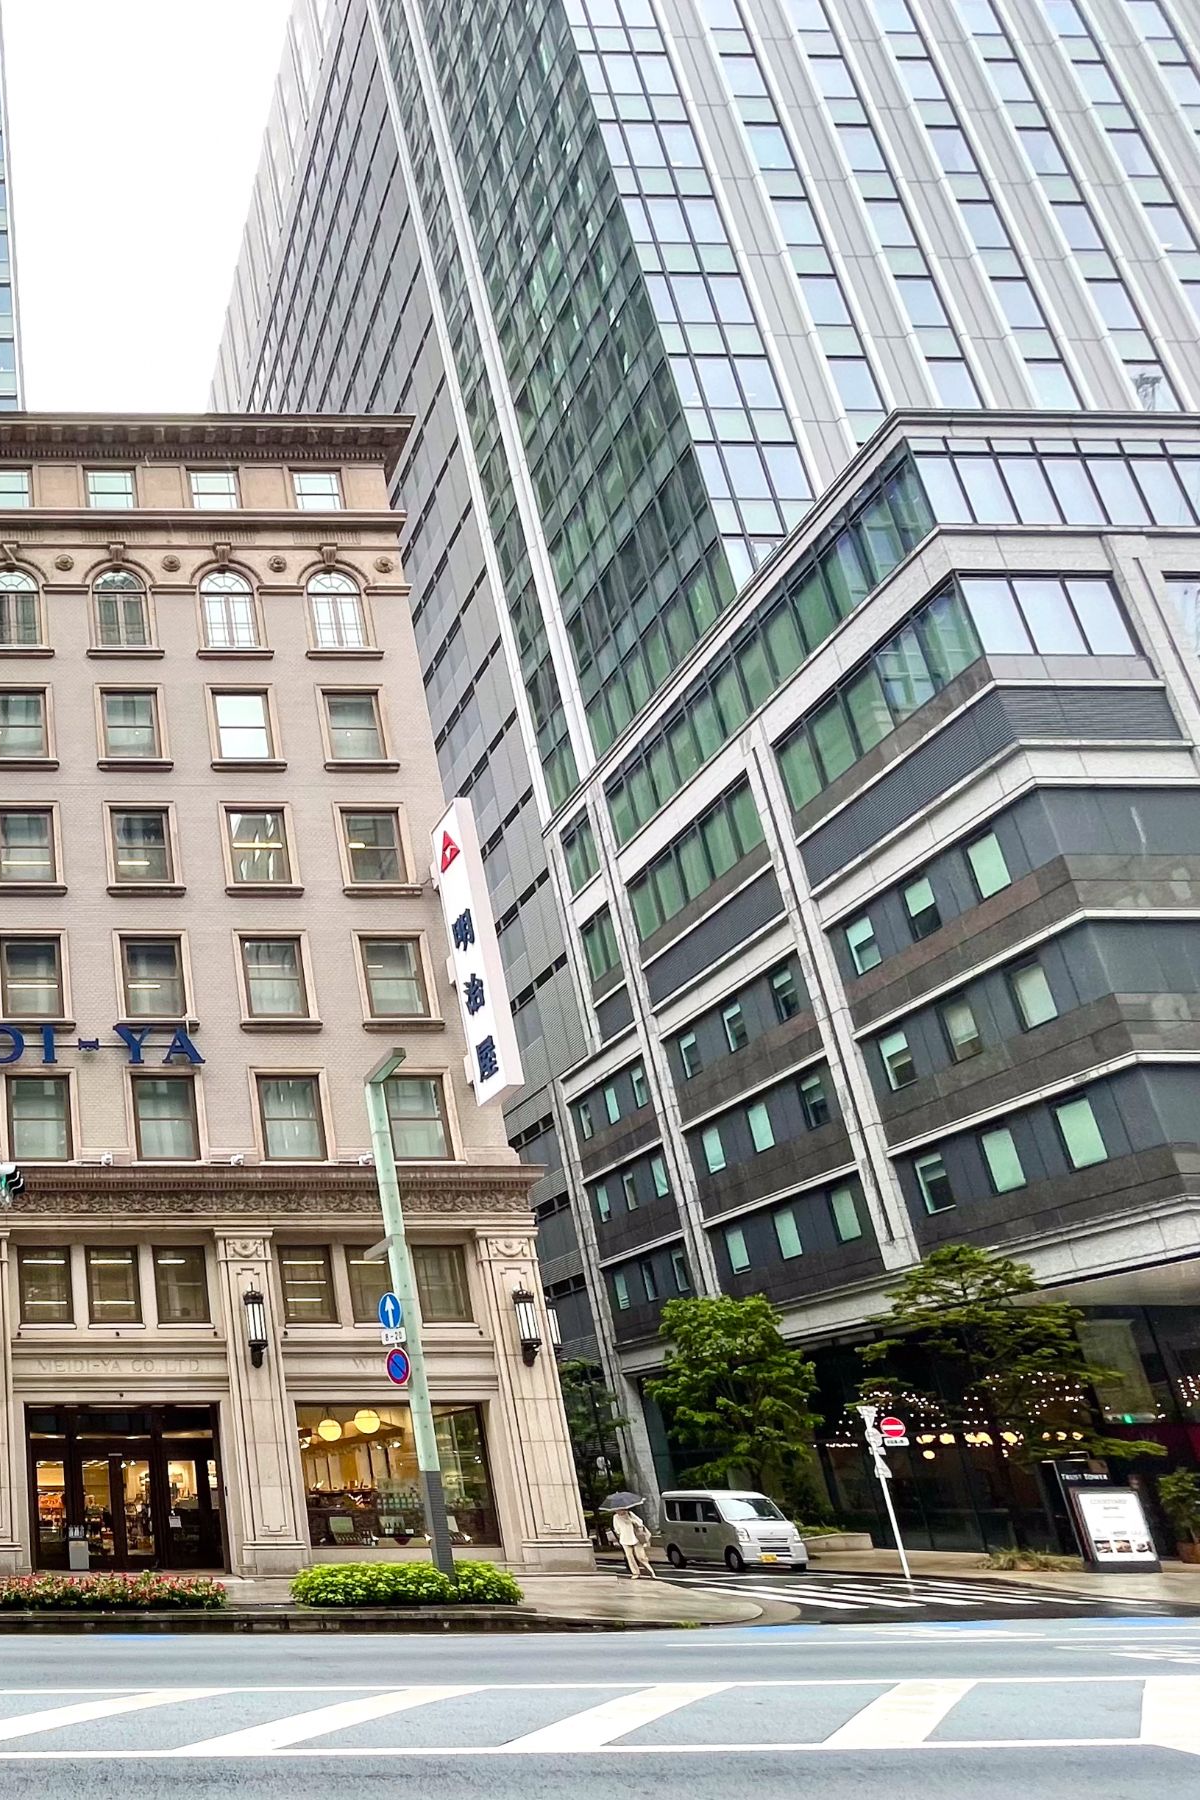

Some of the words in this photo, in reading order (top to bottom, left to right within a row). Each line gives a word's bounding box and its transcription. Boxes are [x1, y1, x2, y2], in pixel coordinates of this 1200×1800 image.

[451, 908, 499, 1083] 明治屋
[37, 1359, 121, 1373] MEIDI-YA
